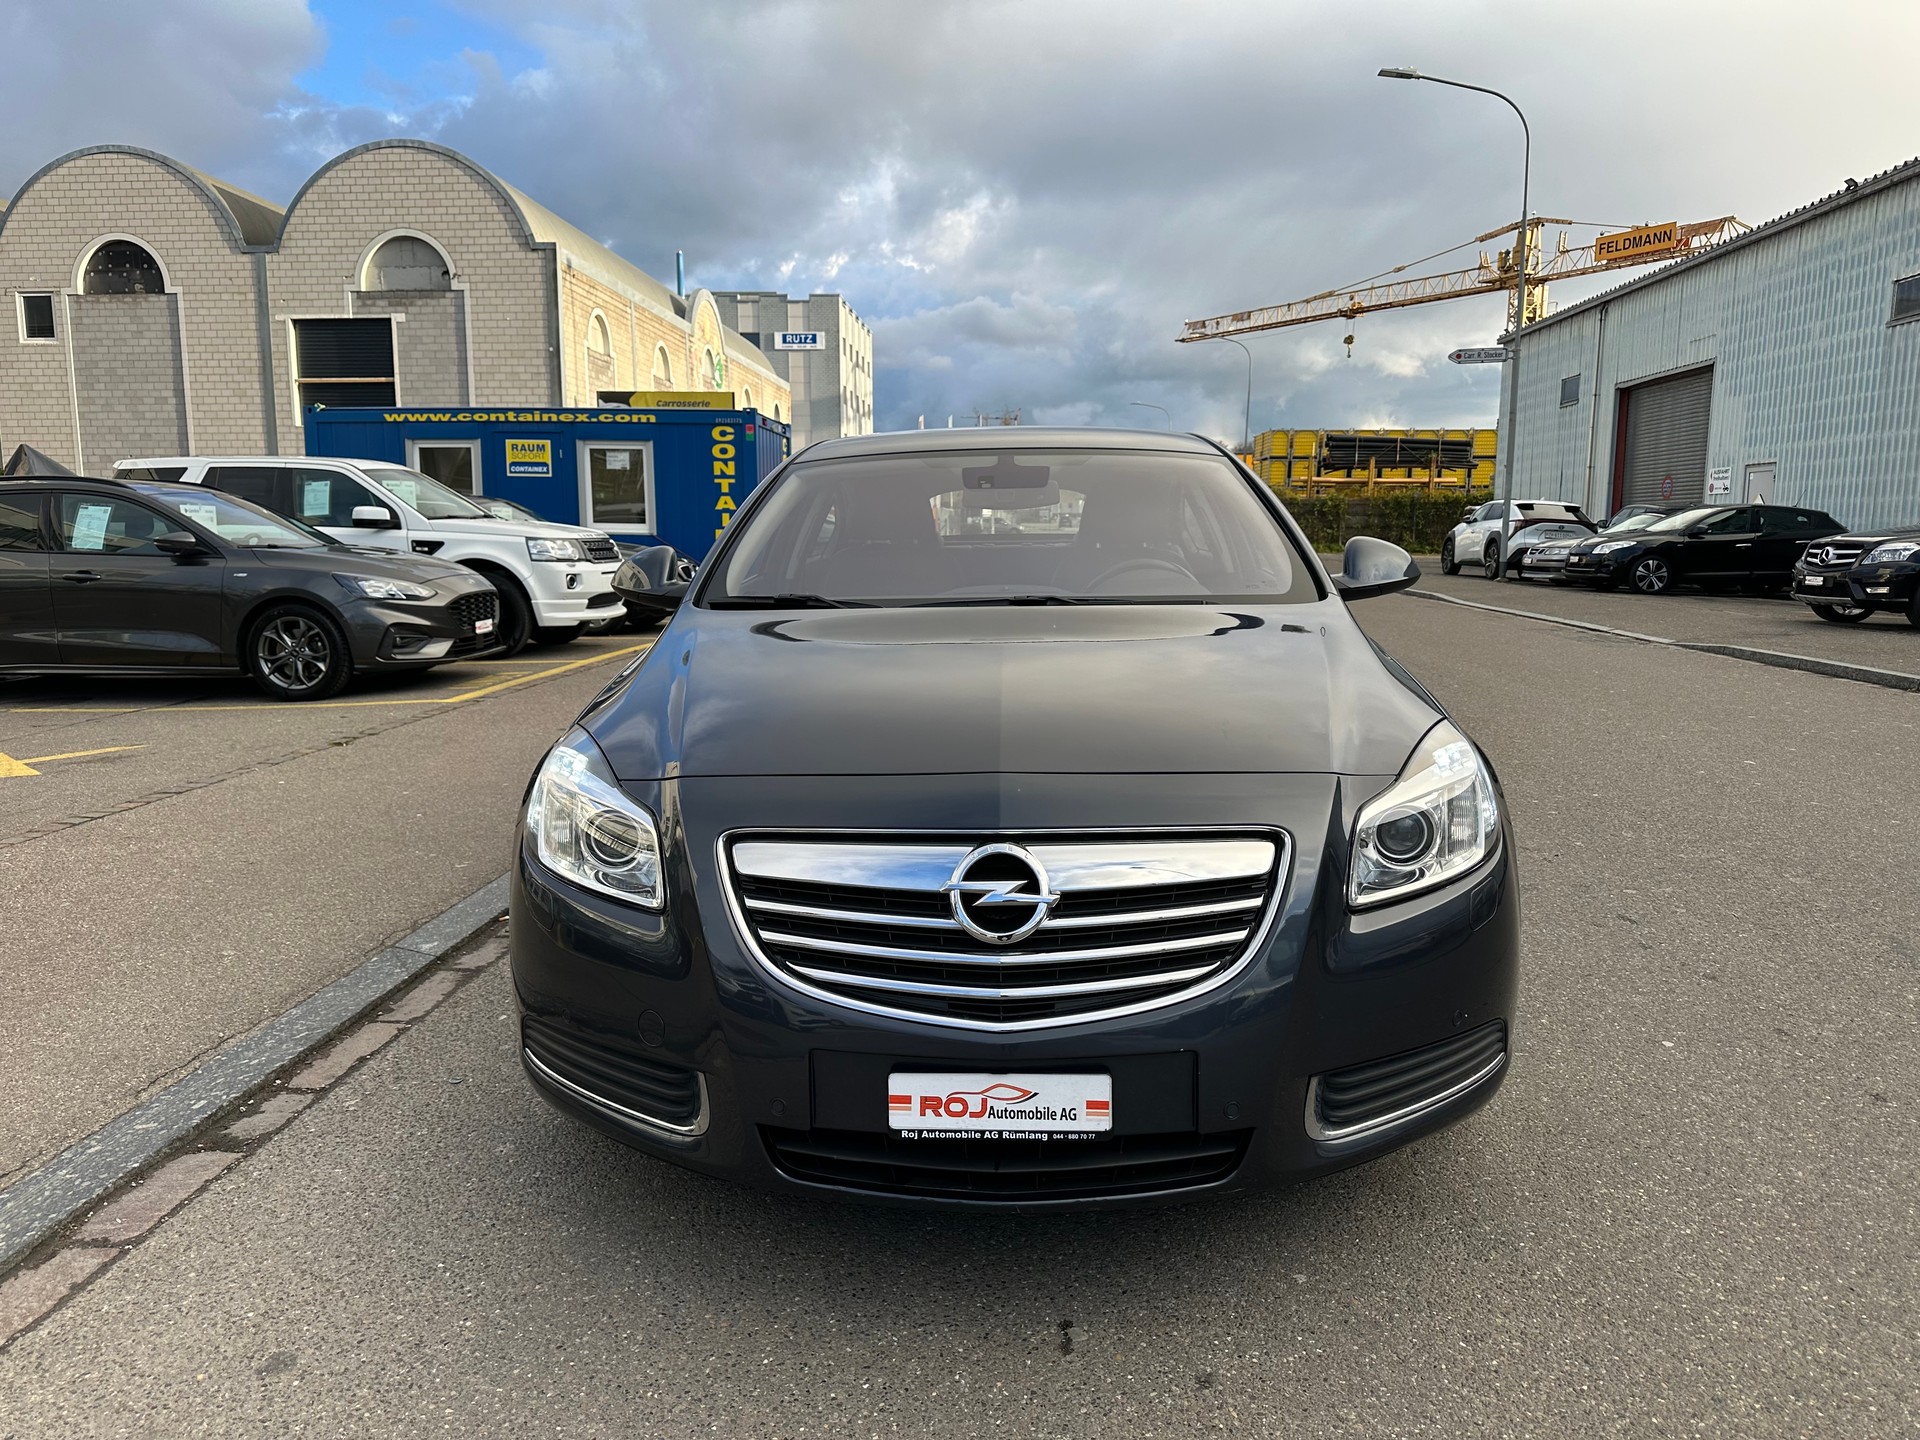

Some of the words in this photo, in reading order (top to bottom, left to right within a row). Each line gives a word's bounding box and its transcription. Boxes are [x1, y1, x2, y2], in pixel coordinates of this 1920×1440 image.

[1598, 229, 1672, 255] FELDMANN
[785, 334, 813, 343] RUTZ
[383, 411, 657, 423] www.containex.com
[511, 444, 546, 452] RAUM
[511, 452, 545, 460] SOFORT
[711, 425, 737, 540] CONTAI
[919, 1096, 988, 1118] ROJ
[988, 1106, 1057, 1120] Automobile
[1059, 1108, 1077, 1121] AG
[901, 1130, 918, 1140] Roj
[921, 1130, 982, 1139] Automobile
[984, 1131, 999, 1139] AG
[1002, 1131, 1048, 1141] Rümlang
